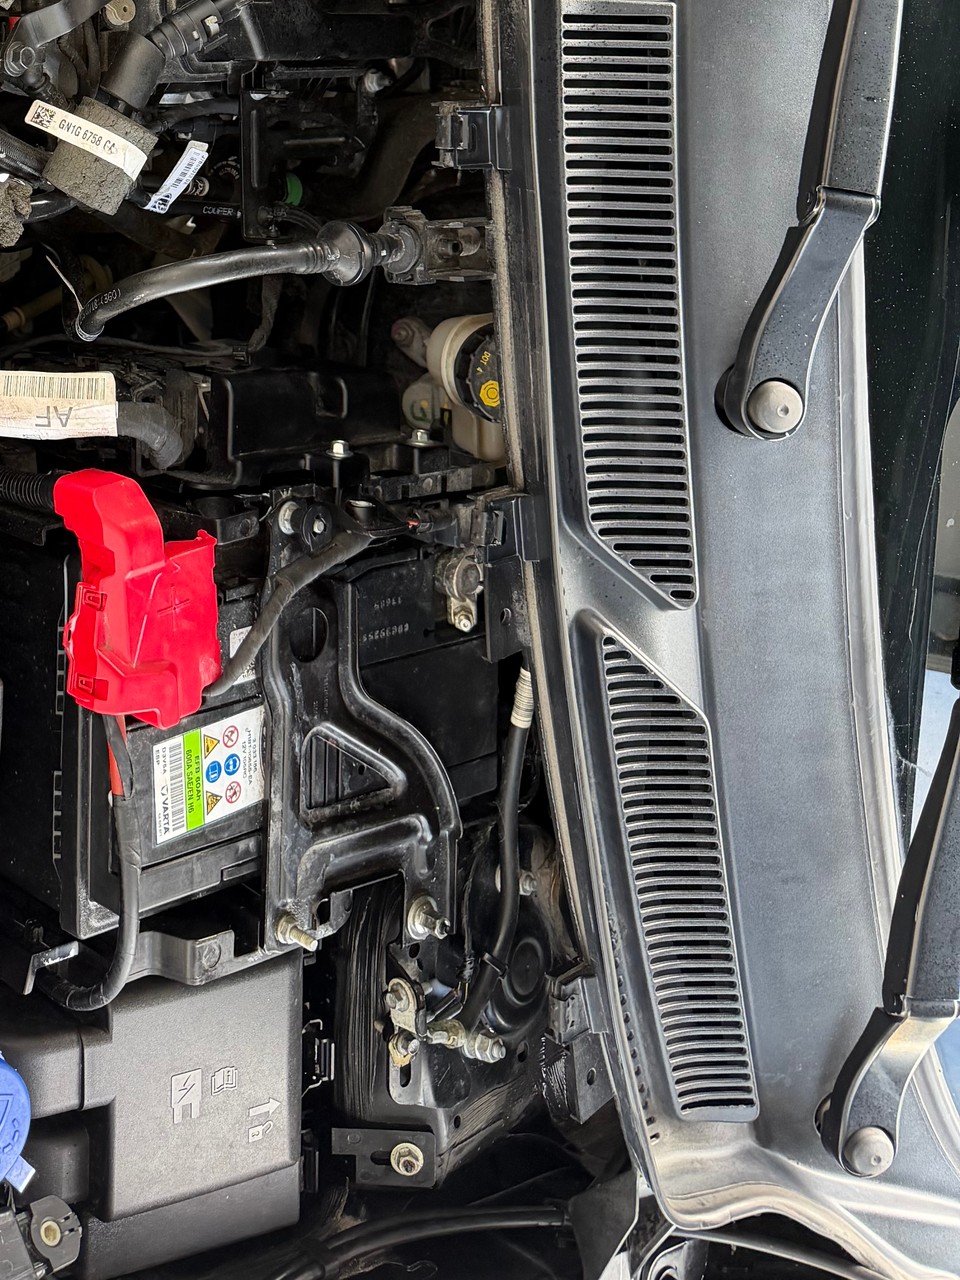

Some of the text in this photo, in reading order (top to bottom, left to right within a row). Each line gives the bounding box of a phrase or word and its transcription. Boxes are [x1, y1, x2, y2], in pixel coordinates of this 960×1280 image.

[58, 119, 82, 137] GN1G
[82, 129, 103, 146] 6758
[480, 351, 491, 365] DOT
[35, 406, 74, 428] AF
[186, 771, 194, 801] SAE/EN
[162, 797, 170, 835] VARTA
[187, 802, 195, 814] H6
